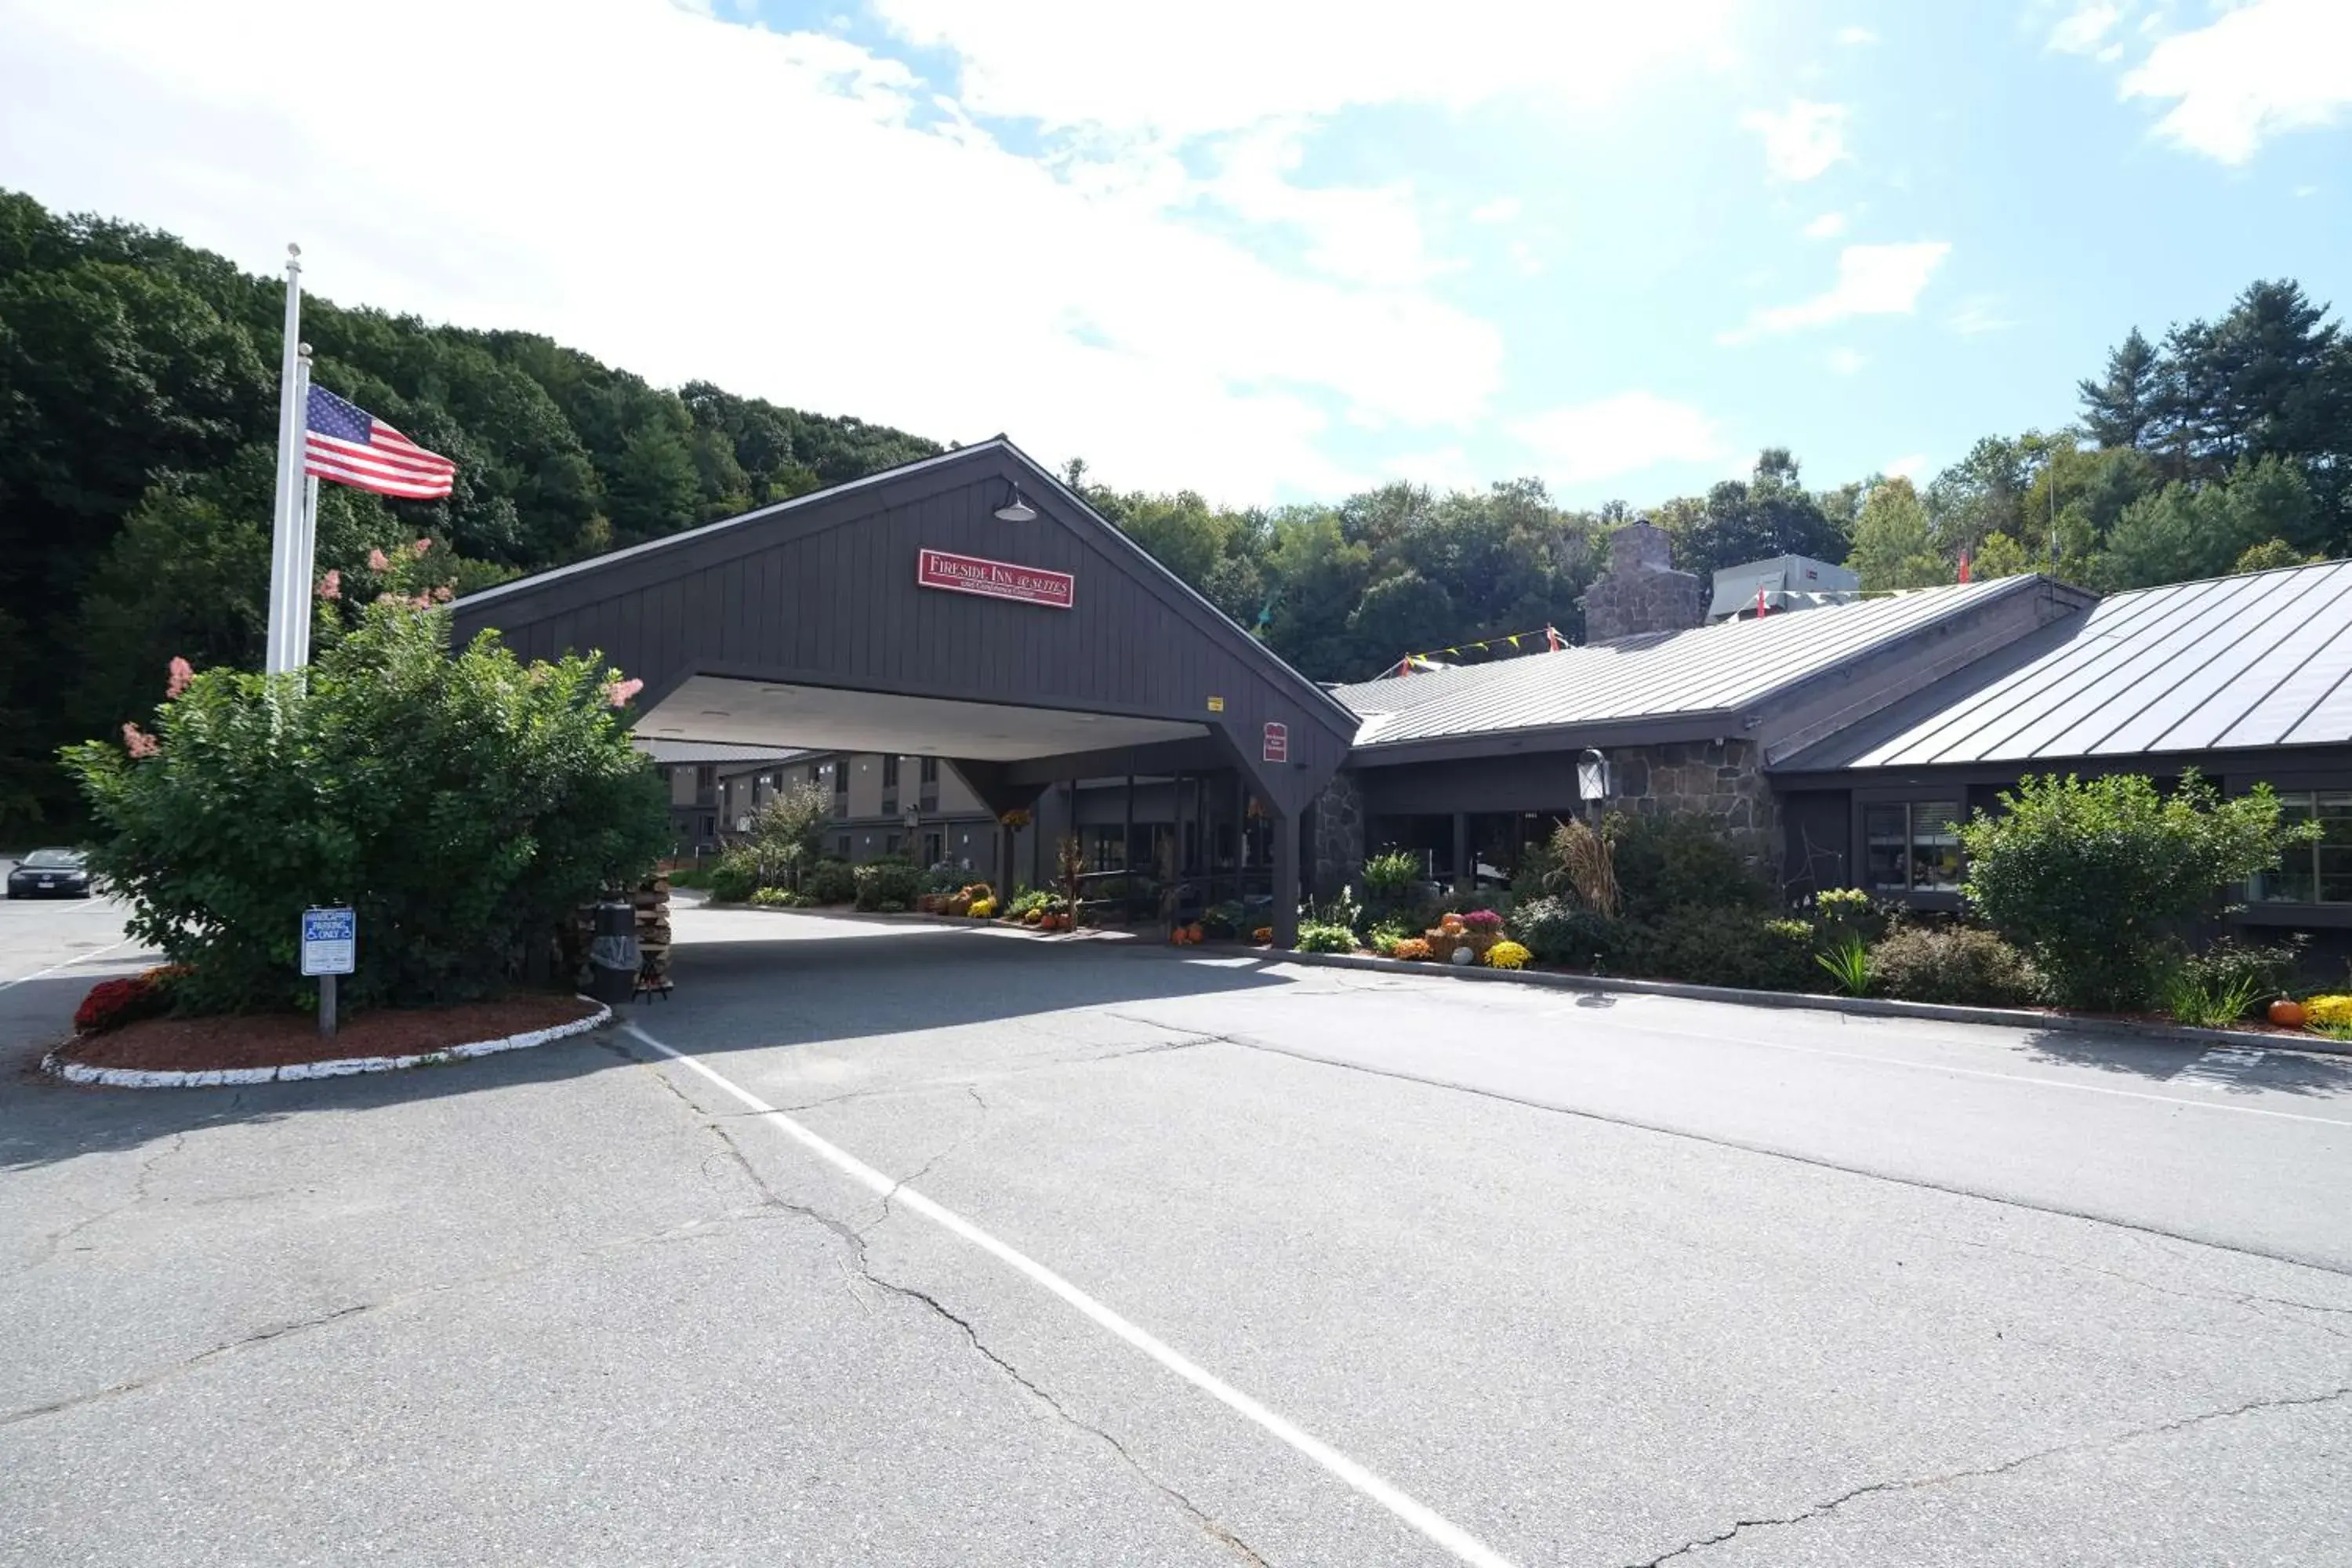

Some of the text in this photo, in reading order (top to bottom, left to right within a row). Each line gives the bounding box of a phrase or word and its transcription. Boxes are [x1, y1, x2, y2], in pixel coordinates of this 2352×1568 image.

[930, 555, 988, 579] FIRESIDE
[991, 565, 1013, 584] INN
[1029, 577, 1067, 593] SUITES
[318, 931, 339, 939] ONLY
